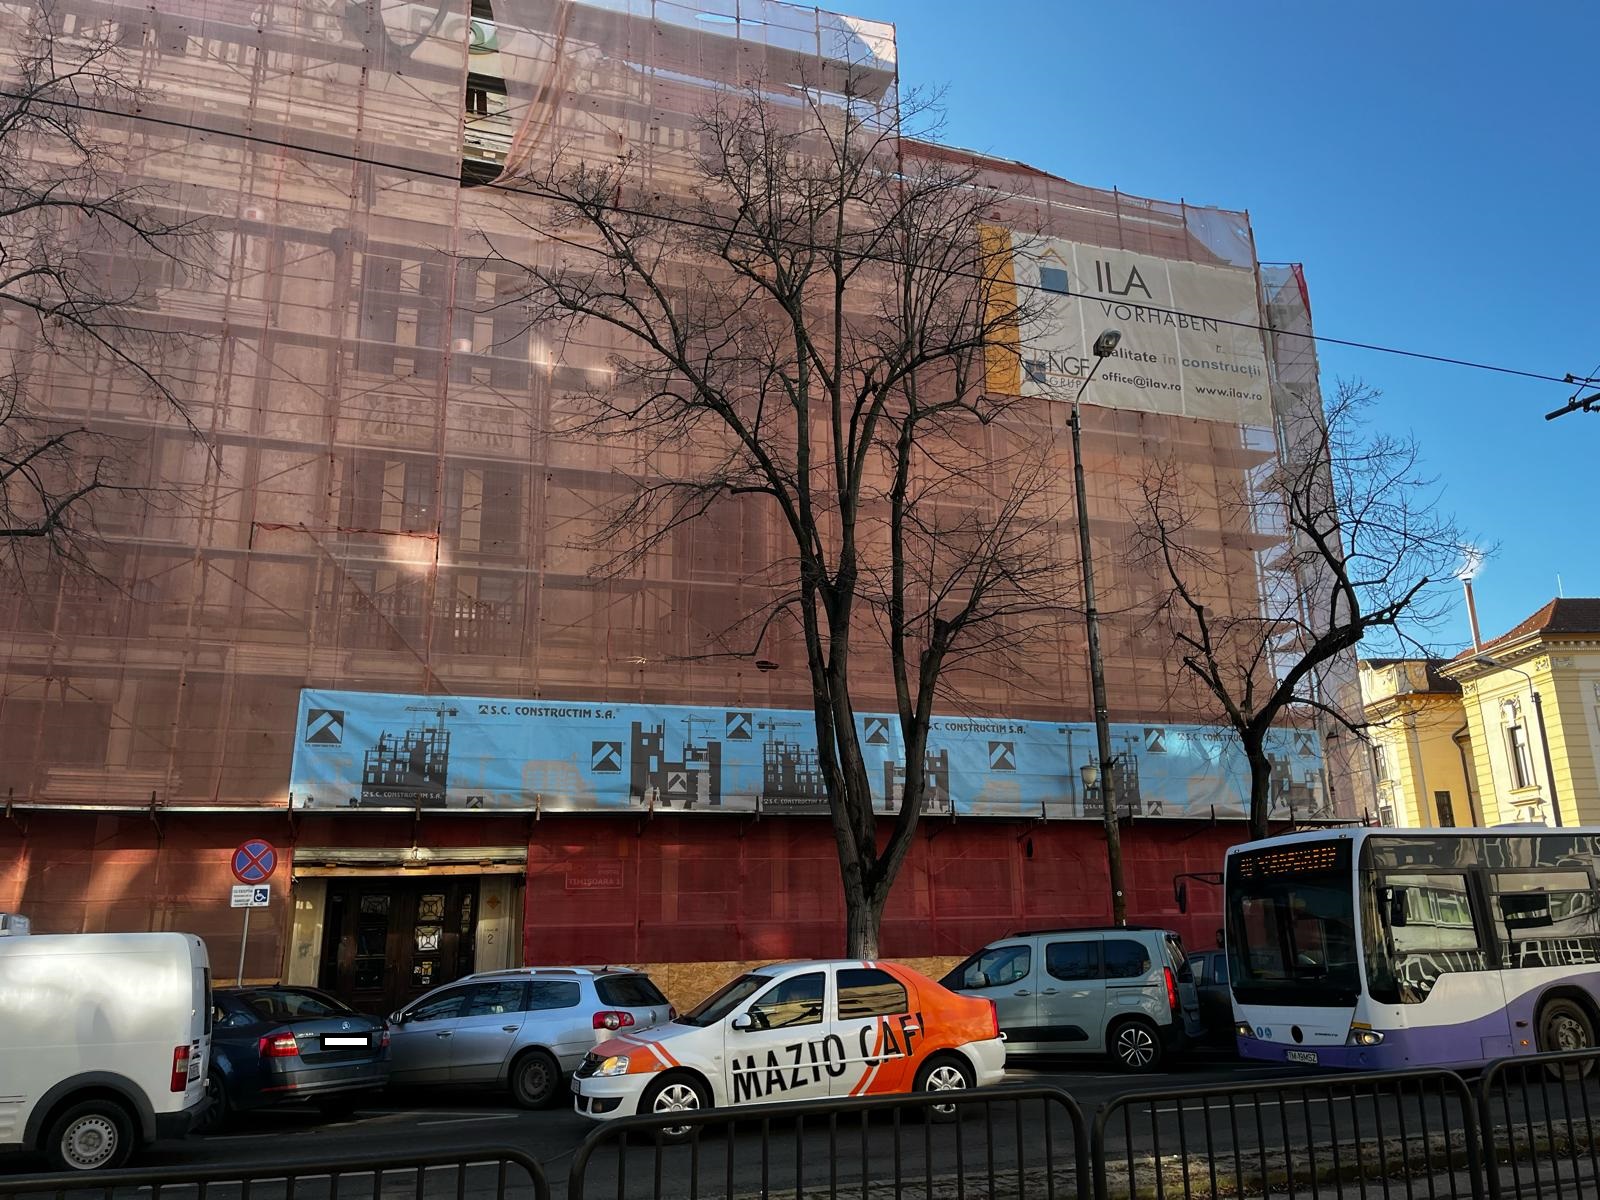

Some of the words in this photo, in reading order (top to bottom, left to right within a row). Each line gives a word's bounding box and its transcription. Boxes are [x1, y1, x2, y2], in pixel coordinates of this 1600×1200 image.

[1095, 260, 1153, 299] ILA
[1099, 301, 1219, 334] VORHABEN
[1106, 345, 1158, 363] alitate
[1102, 371, 1182, 393] office@ilav.ro
[1195, 384, 1263, 402] www.ilav.ro
[490, 705, 511, 716] S.C.
[514, 706, 592, 719] CONSTRUCTIM
[595, 709, 616, 720] S.A.
[945, 722, 1007, 734] CONSTRUCTIM
[1008, 725, 1027, 735] S.A.
[732, 1033, 847, 1103] MAZIO
